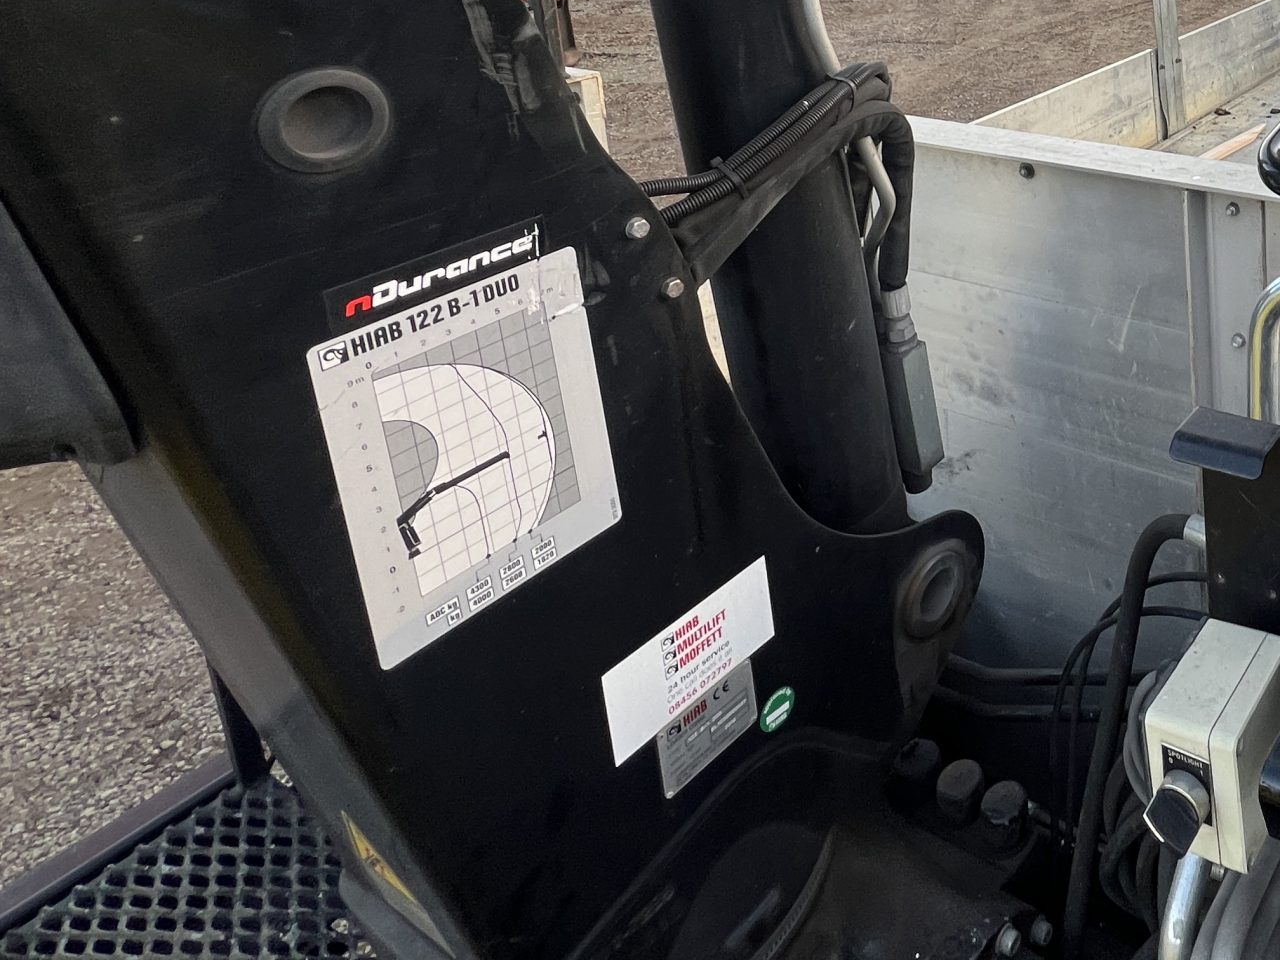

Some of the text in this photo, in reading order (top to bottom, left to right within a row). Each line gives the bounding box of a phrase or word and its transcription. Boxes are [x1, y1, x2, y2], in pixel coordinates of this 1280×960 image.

[350, 321, 403, 357] HIAB
[405, 304, 445, 333] 122
[482, 273, 520, 303] DUO
[674, 615, 699, 640] HIAB
[676, 609, 726, 654] MULTILIFT
[679, 626, 722, 669] MOFFETT
[680, 664, 700, 683] hour
[701, 640, 730, 666] service
[668, 687, 698, 715] 08456
[699, 657, 732, 689] 072797
[682, 698, 708, 727] HIAB
[1167, 748, 1203, 769] SPOTLIGHT
